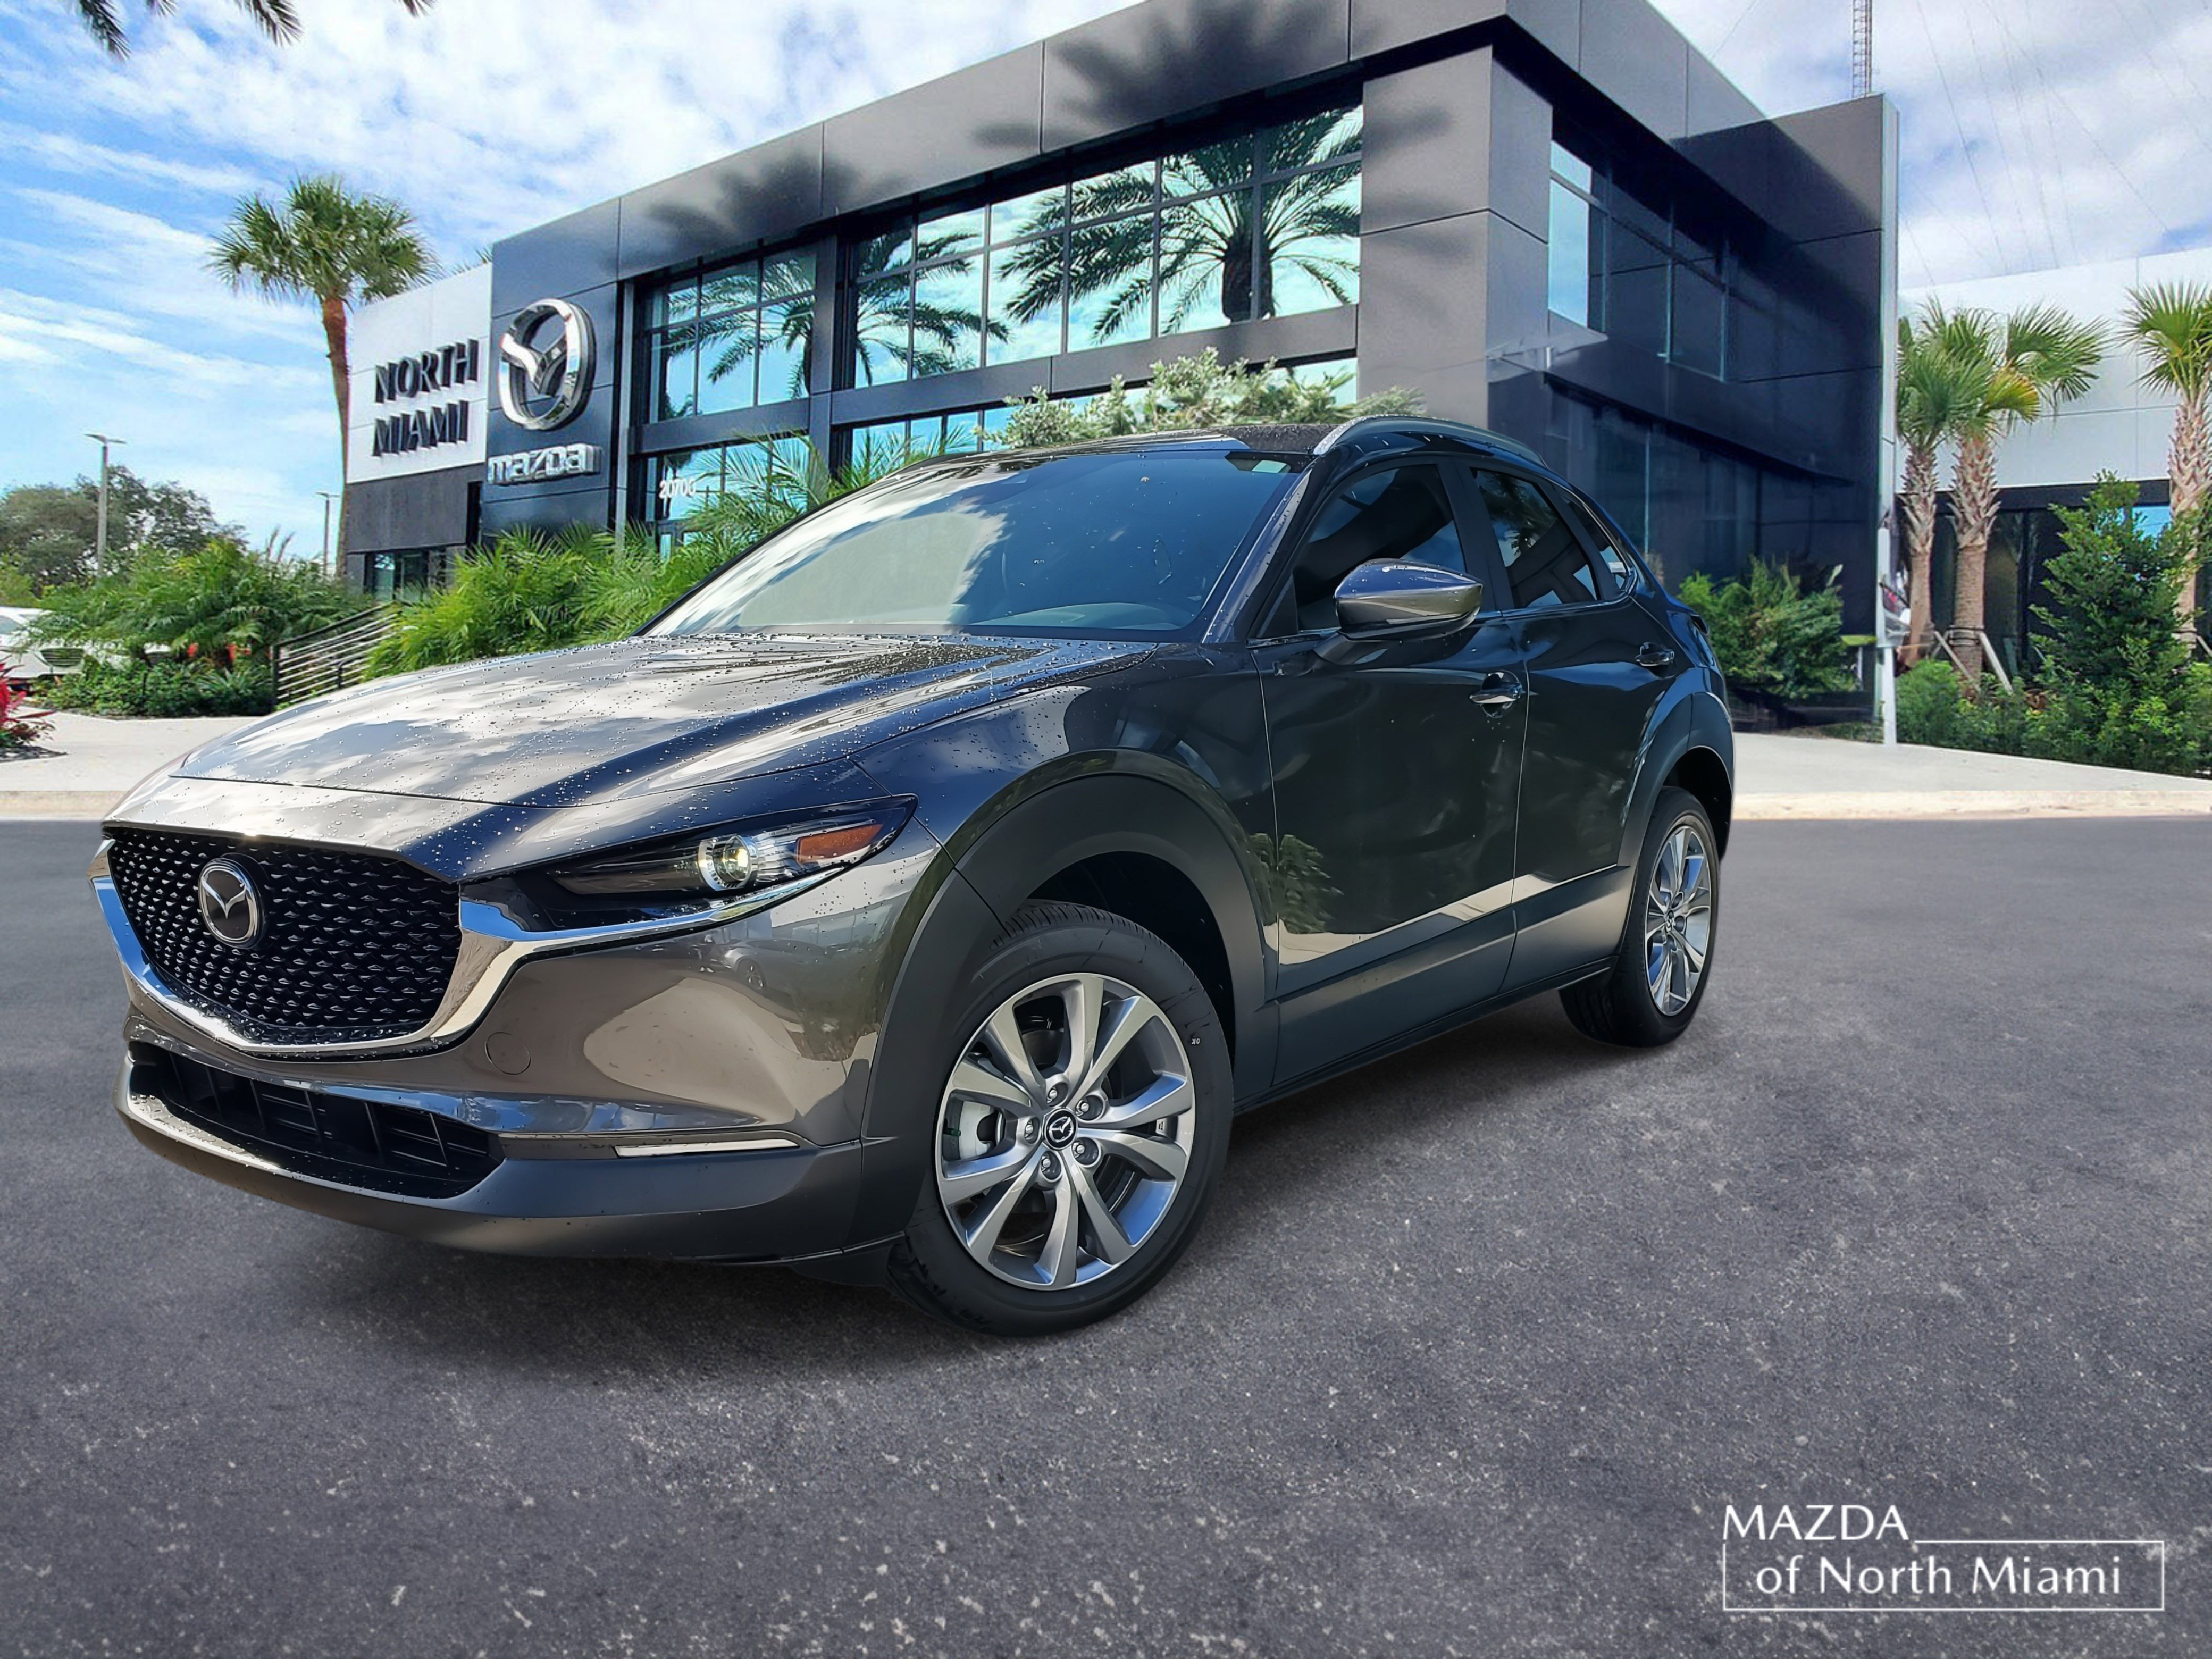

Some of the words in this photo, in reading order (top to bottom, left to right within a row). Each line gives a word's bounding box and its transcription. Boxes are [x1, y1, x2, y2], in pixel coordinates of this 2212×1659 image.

[374, 339, 479, 403] NORTH
[372, 400, 469, 456] MIAMI
[488, 443, 602, 484] mazda
